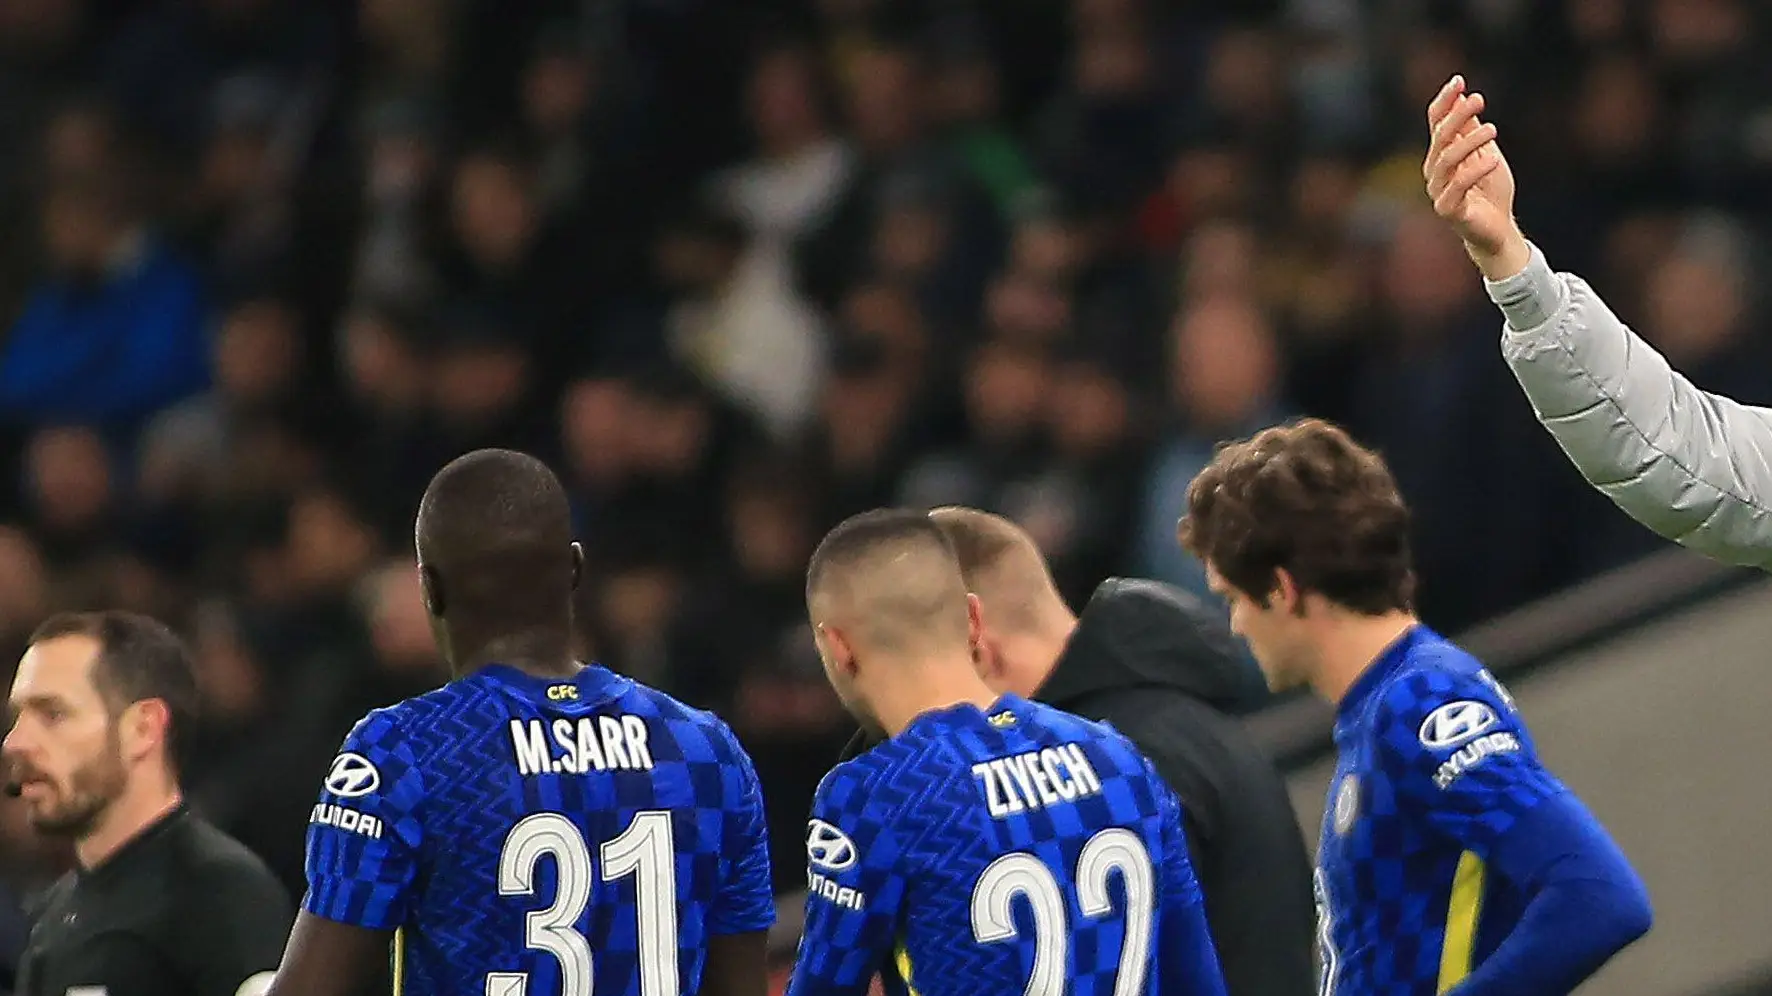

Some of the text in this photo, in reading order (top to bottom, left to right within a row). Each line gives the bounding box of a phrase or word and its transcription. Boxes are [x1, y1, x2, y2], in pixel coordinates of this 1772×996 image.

[547, 685, 579, 700] CFC
[510, 714, 654, 775] M.SARR
[971, 743, 1101, 818] ZIYECH
